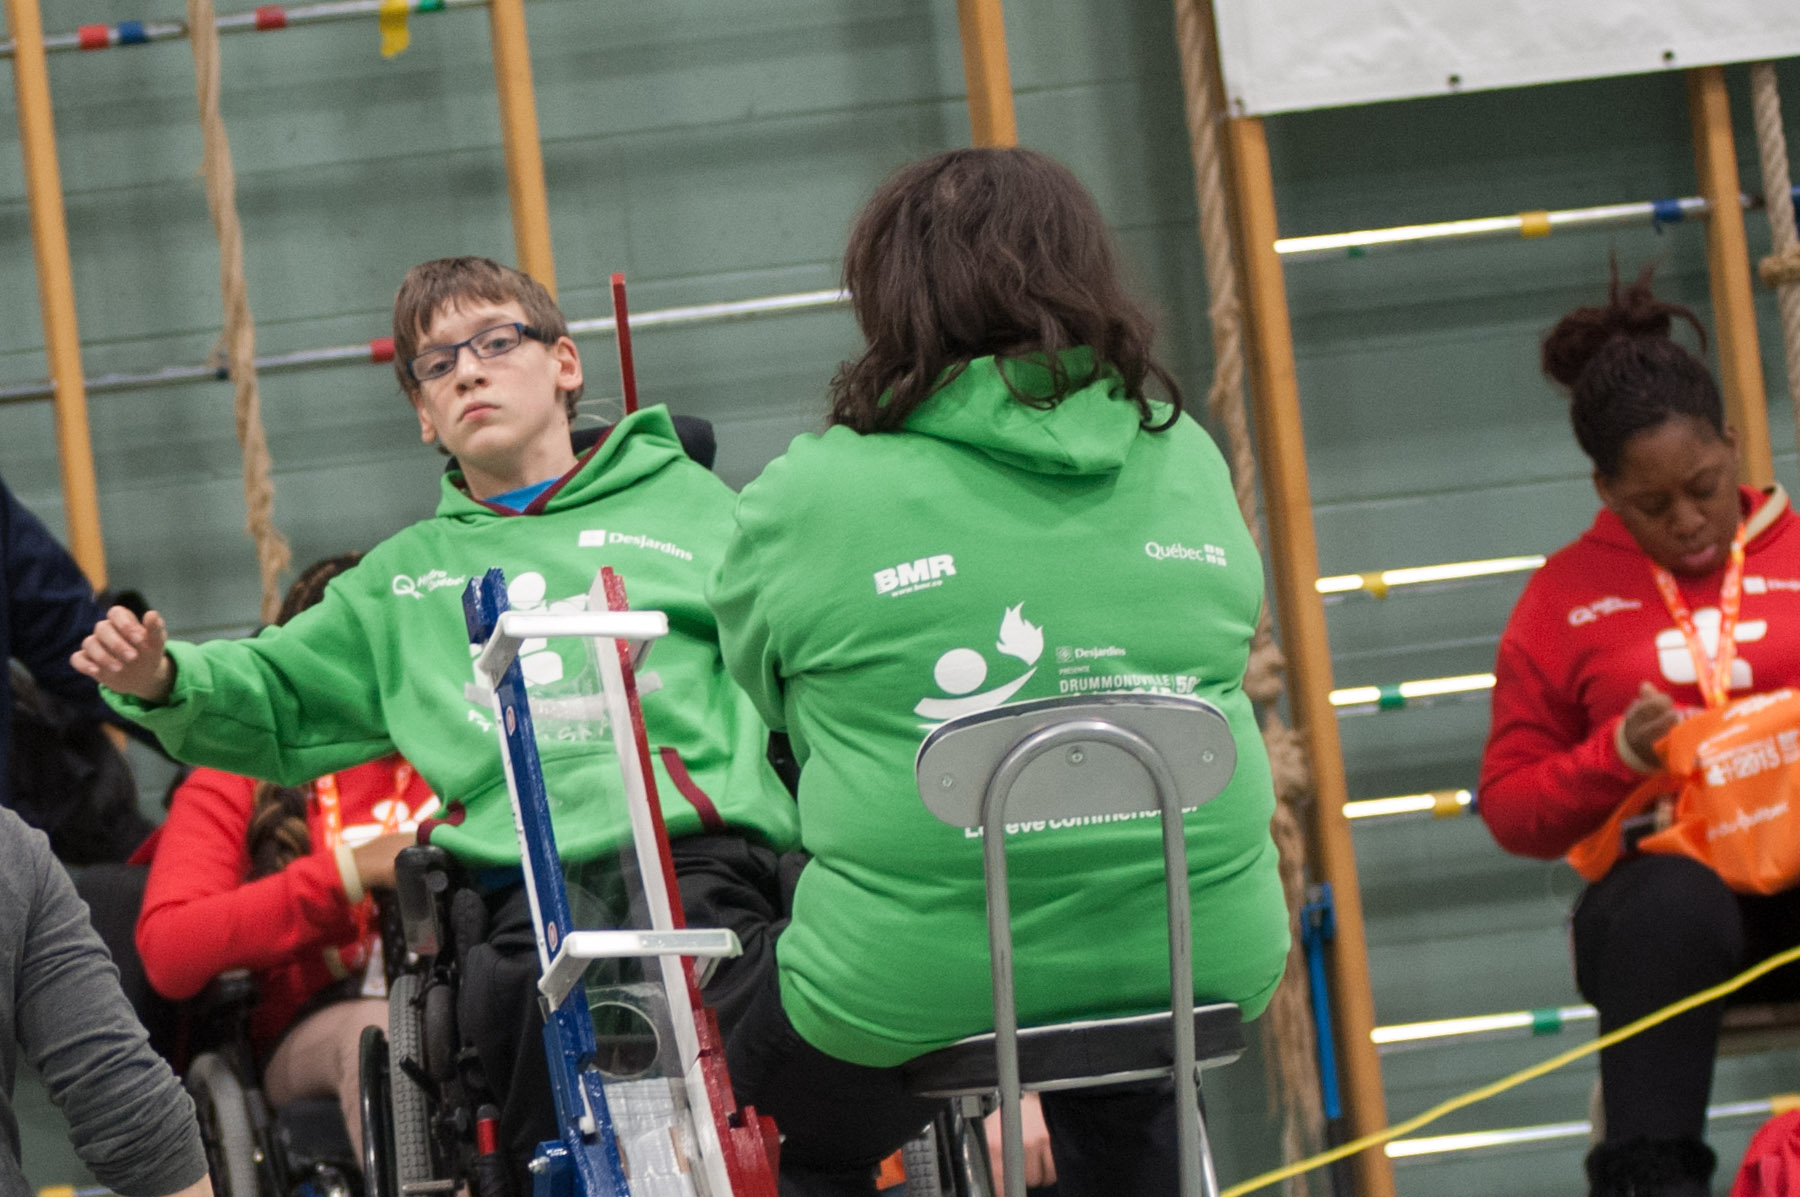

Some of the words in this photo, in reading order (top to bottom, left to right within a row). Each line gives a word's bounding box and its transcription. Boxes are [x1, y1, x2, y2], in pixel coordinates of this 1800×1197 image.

[608, 532, 693, 561] Desjardins
[1145, 541, 1204, 561] Québec
[873, 554, 957, 595] BMR
[1074, 646, 1127, 660] Desjardins
[1060, 674, 1170, 693] DRUMMONDVILLE
